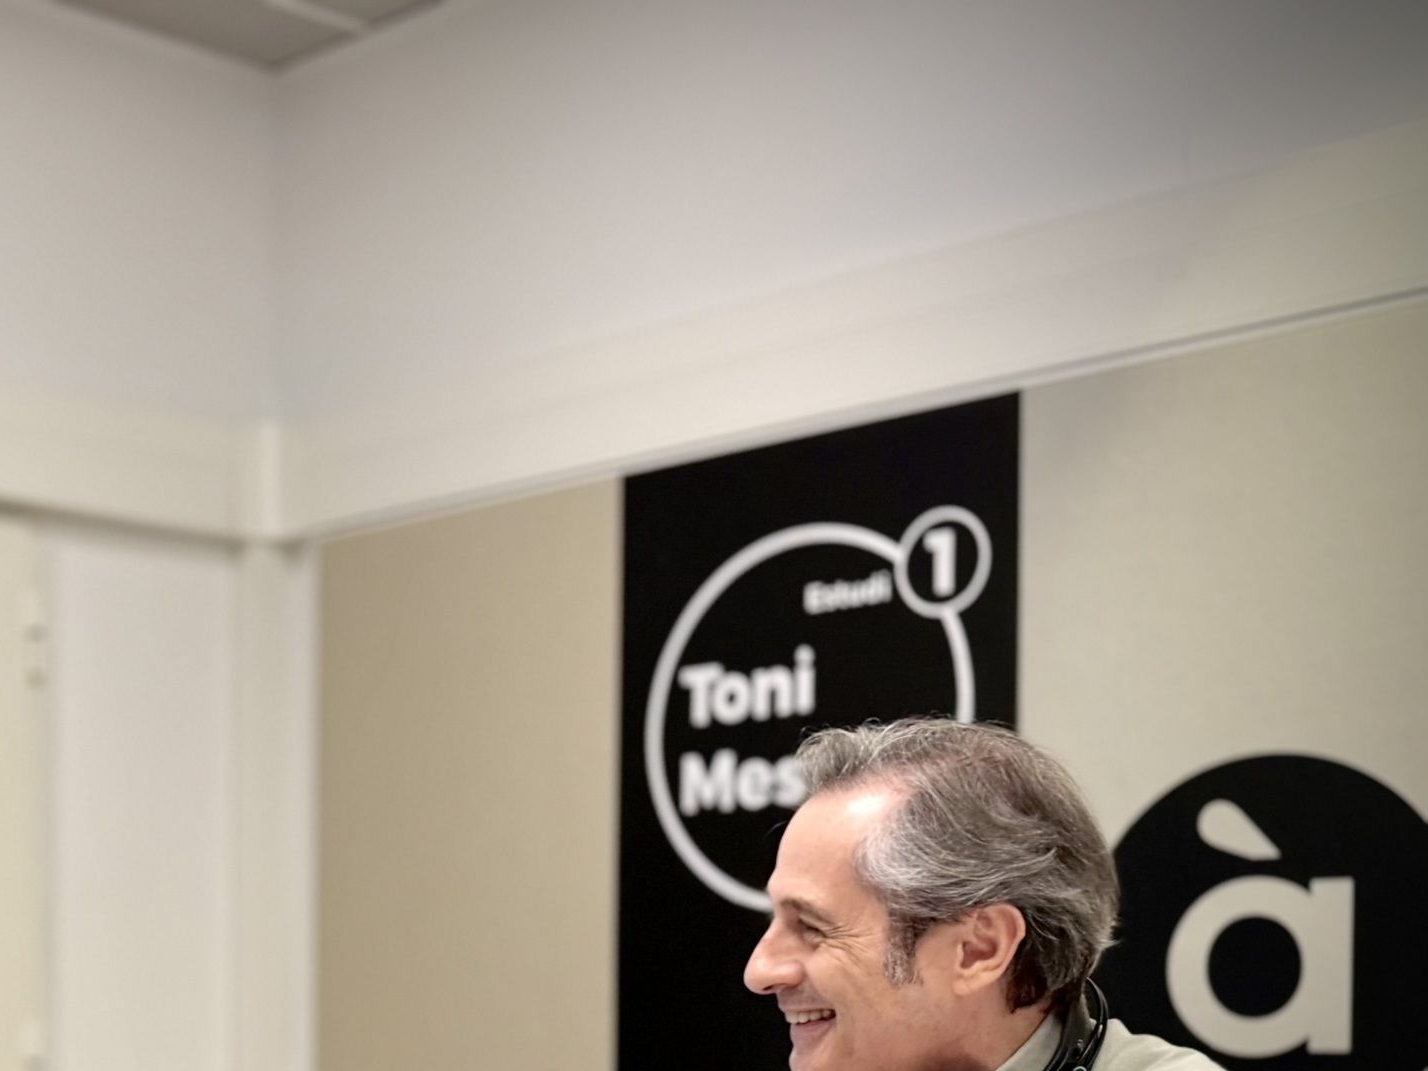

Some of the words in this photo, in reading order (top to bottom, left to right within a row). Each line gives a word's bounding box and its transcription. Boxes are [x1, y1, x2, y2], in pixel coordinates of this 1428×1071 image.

[924, 526, 957, 598] 1
[677, 643, 817, 729] Toni
[678, 748, 808, 818] Mes
[1165, 798, 1357, 1059] à
